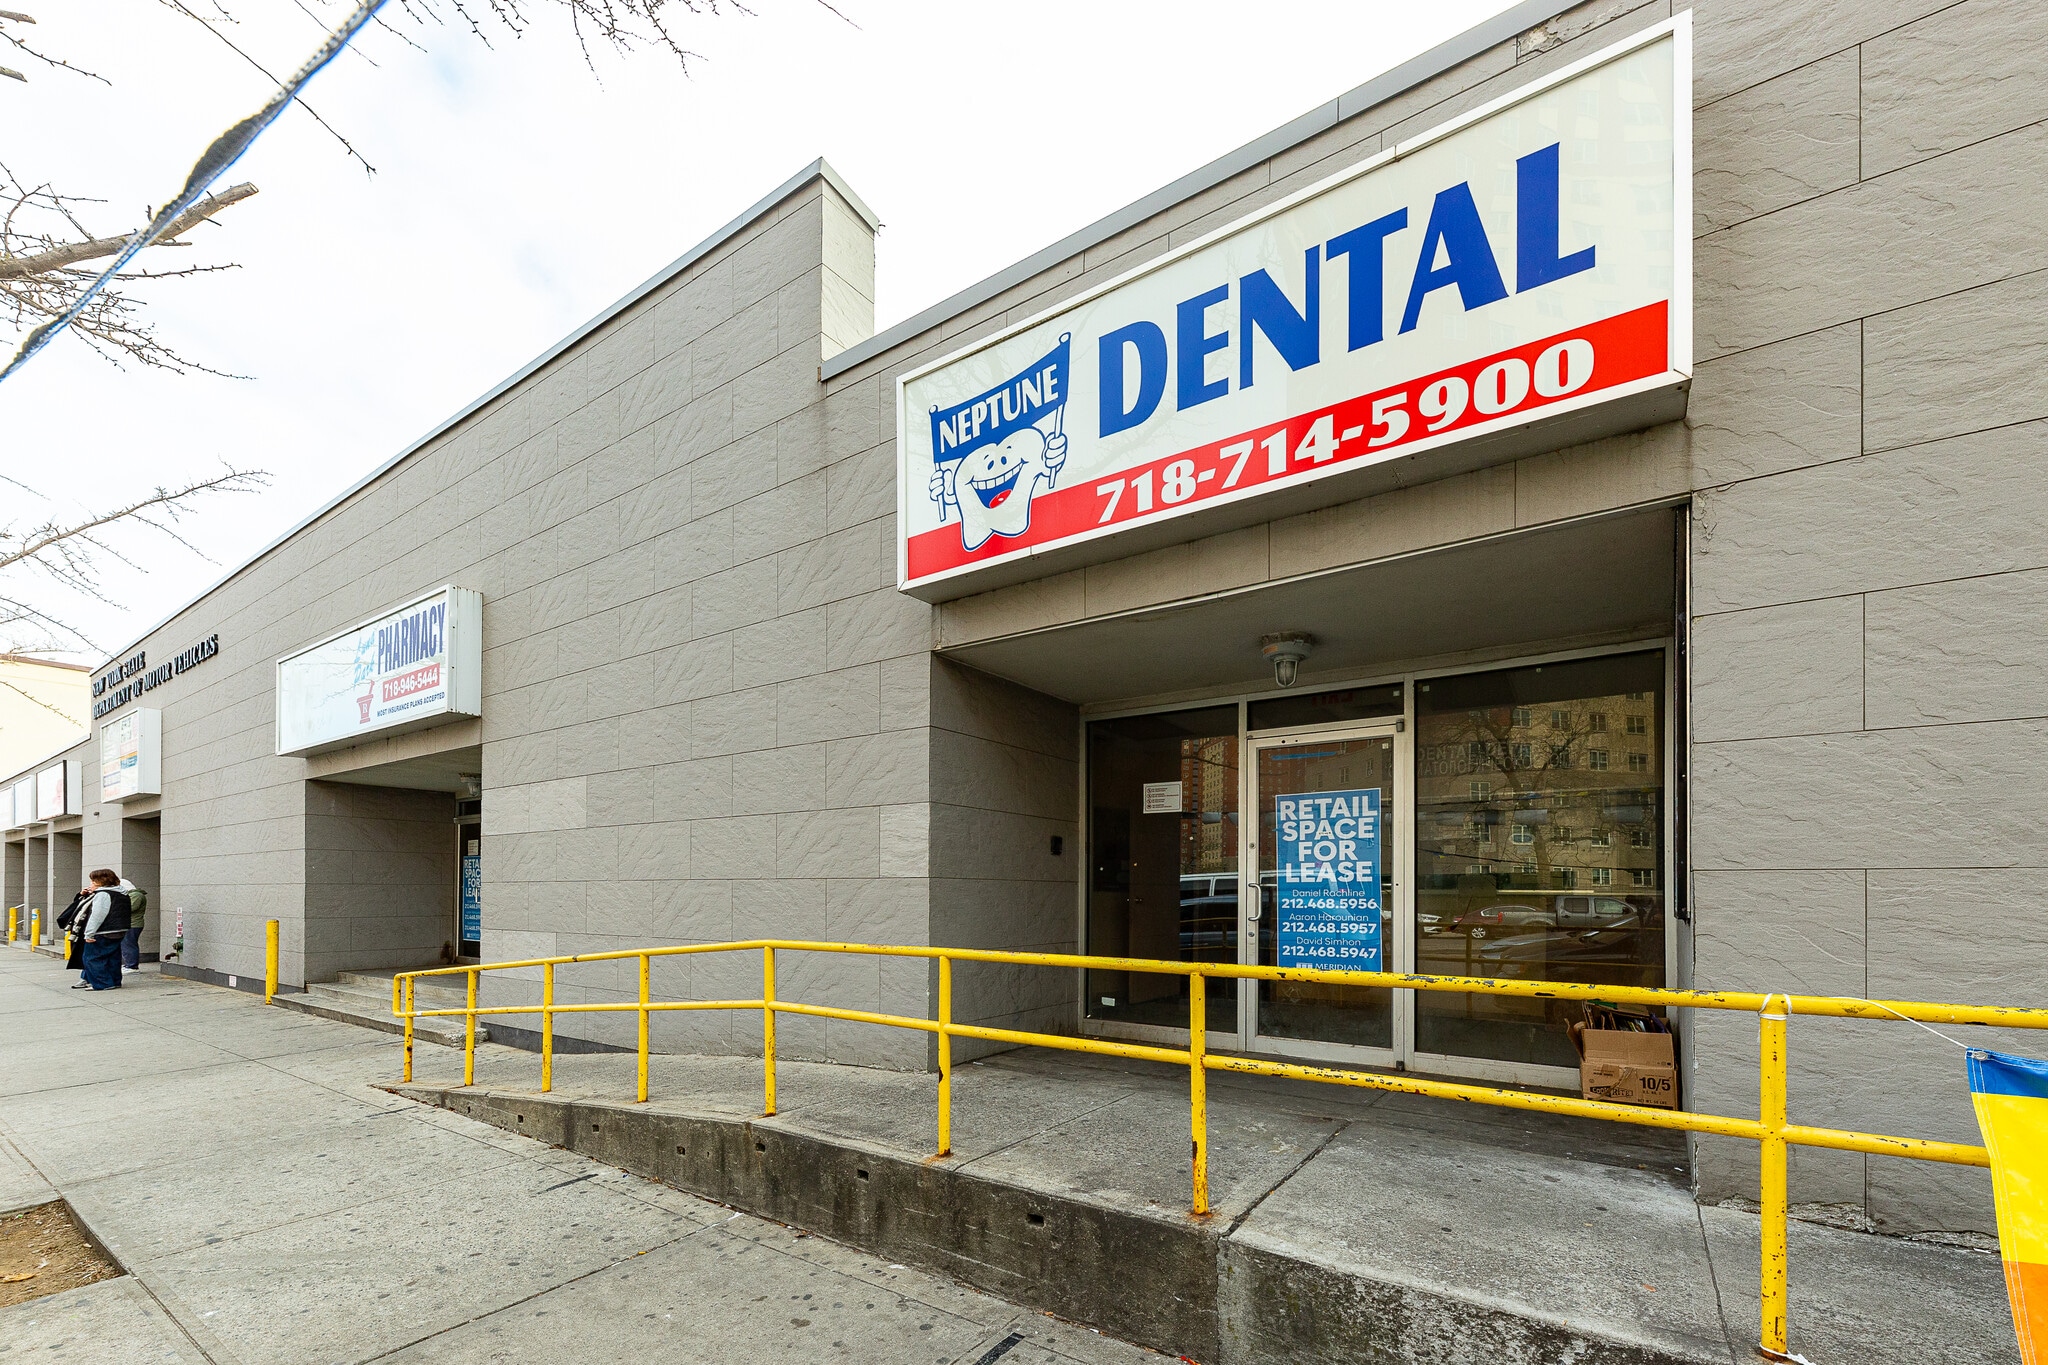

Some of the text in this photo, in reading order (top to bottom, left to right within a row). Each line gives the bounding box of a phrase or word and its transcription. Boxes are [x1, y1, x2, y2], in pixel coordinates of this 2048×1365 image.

[1098, 142, 1595, 437] DENTAL
[939, 363, 1059, 454] NEPTUNE
[1096, 338, 1595, 524] 718-714-5900
[378, 602, 446, 675] PHARMACY
[93, 651, 146, 698] NEW YORK STATE
[93, 634, 219, 720] DEPARTMENT OF MOTOR VEHICLES
[384, 667, 438, 700] 718-946-5444
[377, 691, 446, 717] MOST INSURANCE PLANS ACCEPTED
[1280, 796, 1378, 821] RETAIL
[1282, 817, 1375, 842] SPACE
[1298, 840, 1358, 862] FOR
[464, 859, 480, 869] RETA
[1286, 861, 1373, 883] LEASE
[465, 869, 481, 878] SPAC
[465, 887, 480, 897] LEA
[467, 878, 481, 888] FOR
[1292, 889, 1365, 897] Daniel Rachline
[1281, 898, 1377, 909] 212.468.5956
[1289, 913, 1316, 921] Aaron
[1282, 922, 1377, 934] 212.468.5957
[1296, 937, 1361, 946] David Simhon
[1282, 946, 1377, 959] 212.468.5947
[1315, 963, 1361, 971] MERIDIAN
[1639, 1077, 1671, 1092] 10/5
